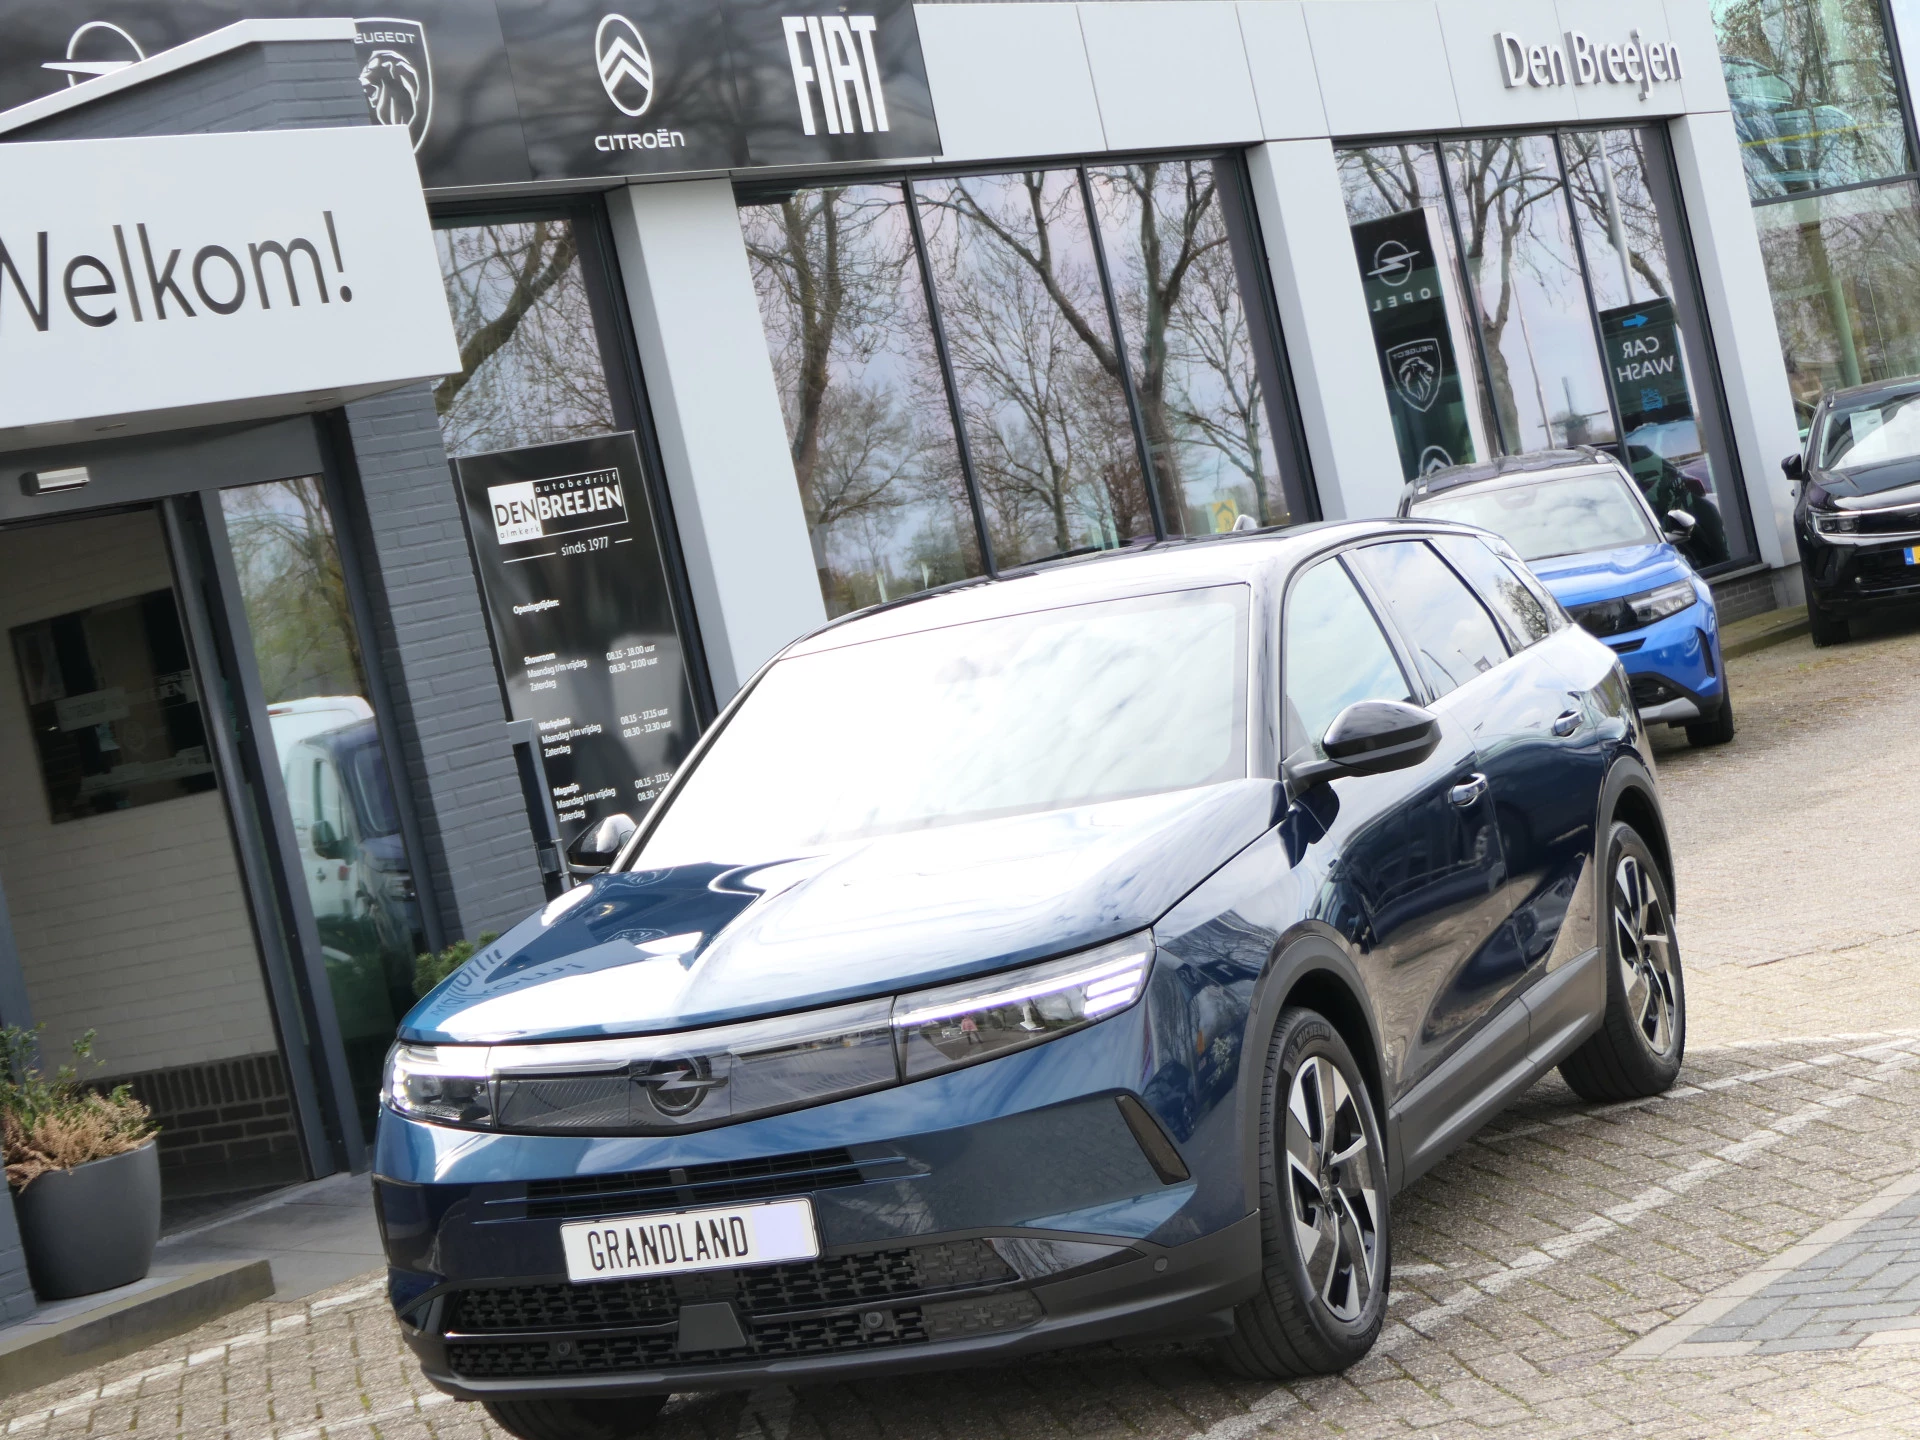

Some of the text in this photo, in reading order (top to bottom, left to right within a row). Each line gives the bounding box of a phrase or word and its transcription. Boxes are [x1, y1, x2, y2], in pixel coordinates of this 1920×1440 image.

[354, 31, 415, 44] EUGEOT
[1493, 28, 1684, 101] Den Breejen
[781, 16, 890, 136] FIAT
[535, 471, 617, 493] autobedrijf
[494, 484, 622, 527] DEN BREEJEN
[561, 536, 609, 556] sinds 1977
[527, 666, 555, 678] Maandag
[530, 680, 557, 691] Zaterdag
[541, 731, 569, 744] Maandag
[544, 745, 571, 757] Zaterdag
[556, 796, 584, 809] Maandag
[559, 810, 585, 822] Zaterdag
[587, 1216, 749, 1271] GRANDLAND
